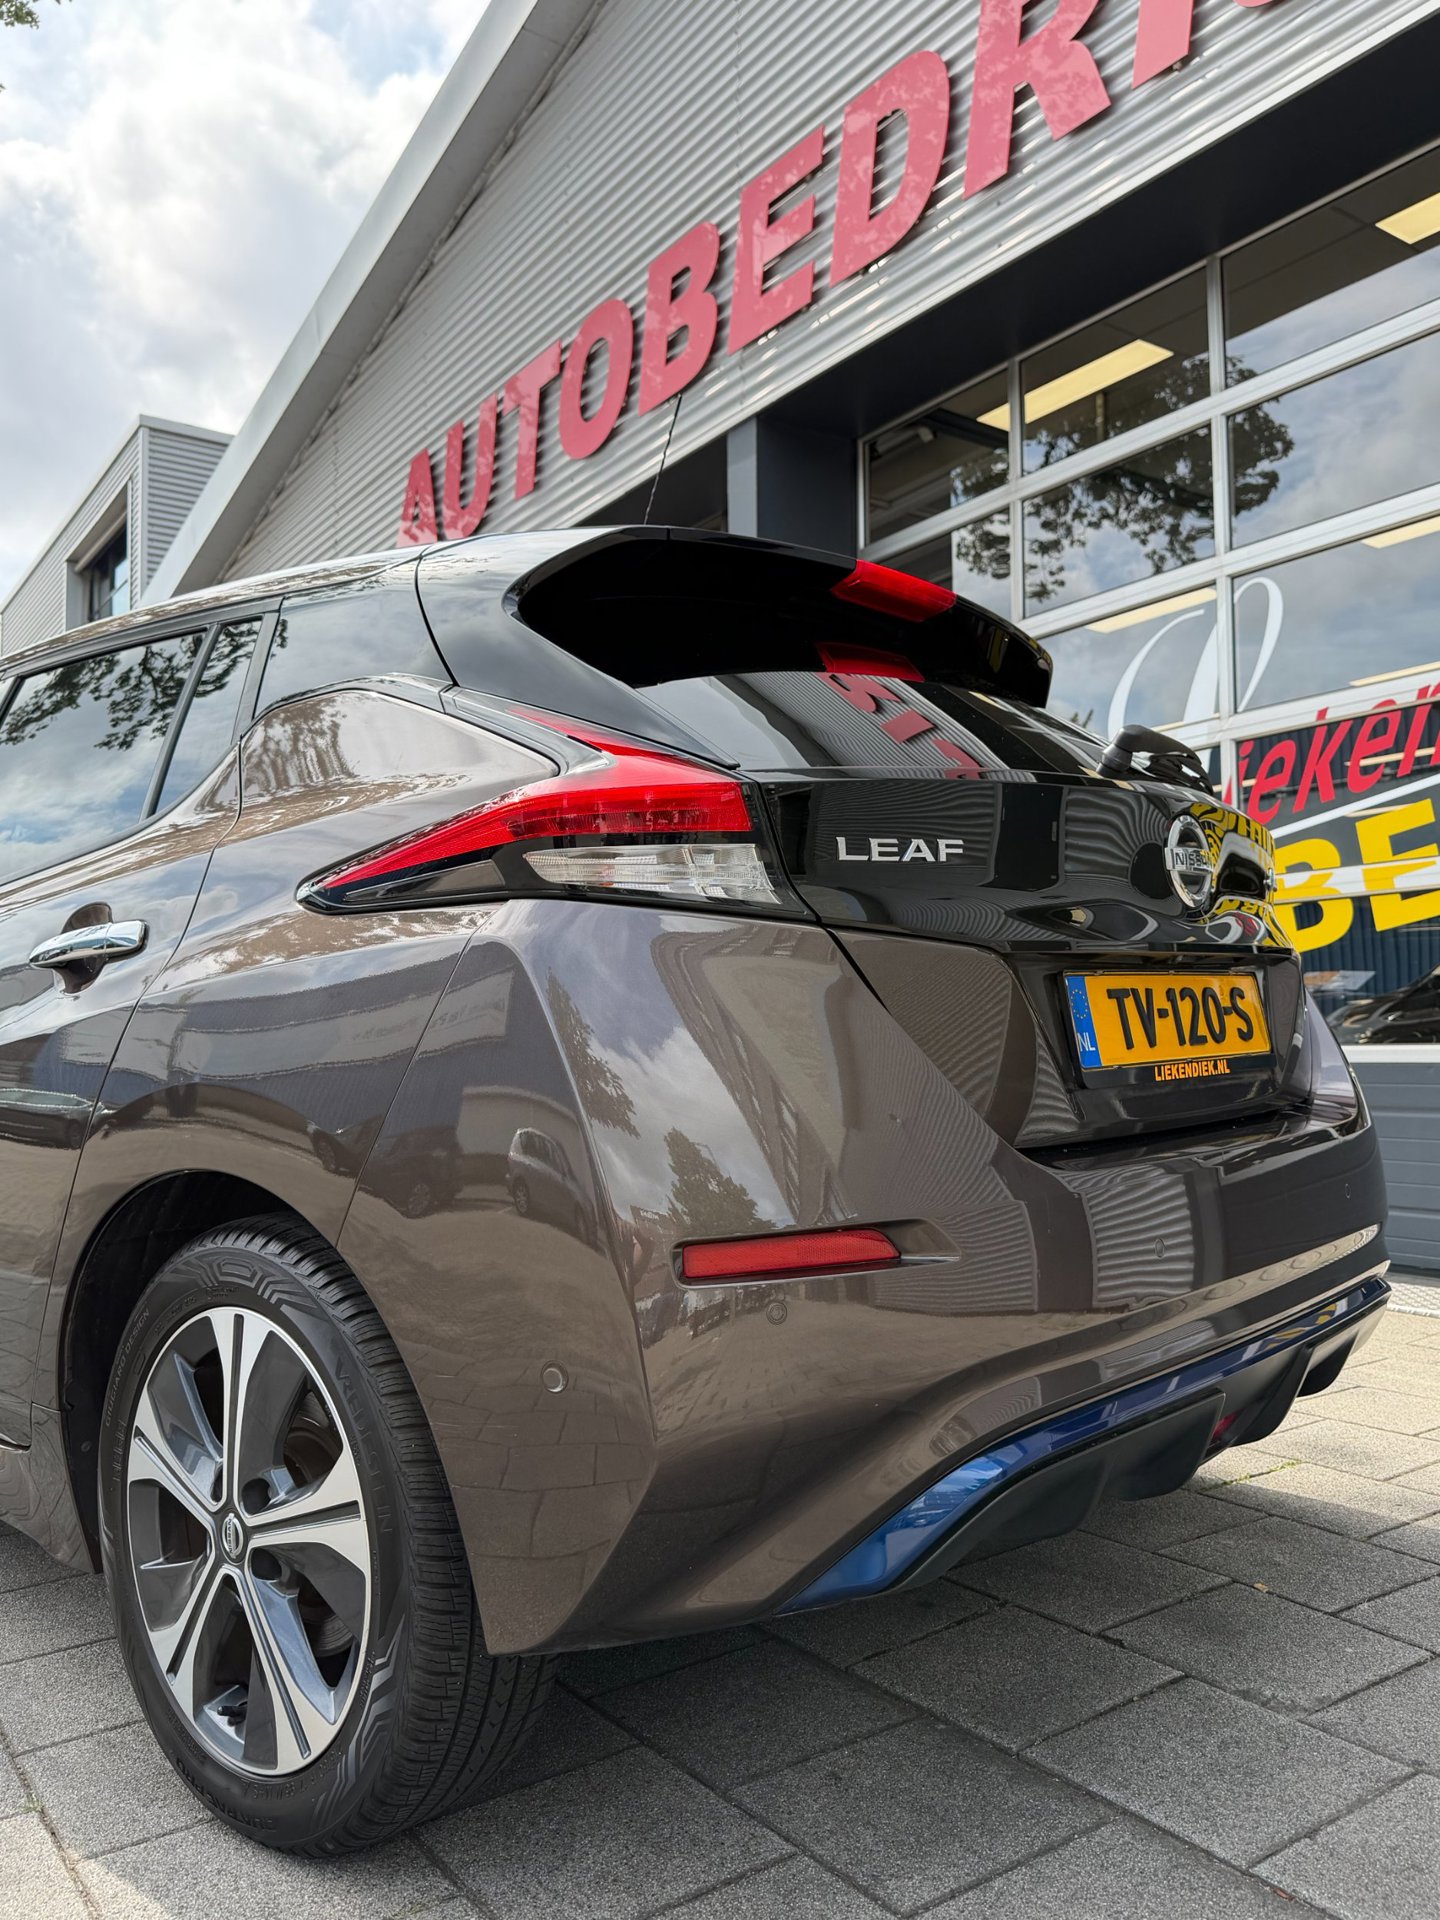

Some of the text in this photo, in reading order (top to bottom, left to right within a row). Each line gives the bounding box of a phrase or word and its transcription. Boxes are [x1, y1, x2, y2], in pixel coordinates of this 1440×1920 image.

[395, 0, 1276, 548] AUTOBEDR
[836, 836, 965, 862] LEAF
[1175, 850, 1212, 869] NISS
[1106, 987, 1254, 1050] TV-120-S
[1077, 1032, 1096, 1052] NL
[1155, 1059, 1231, 1081] LIEKENDIEK.NL
